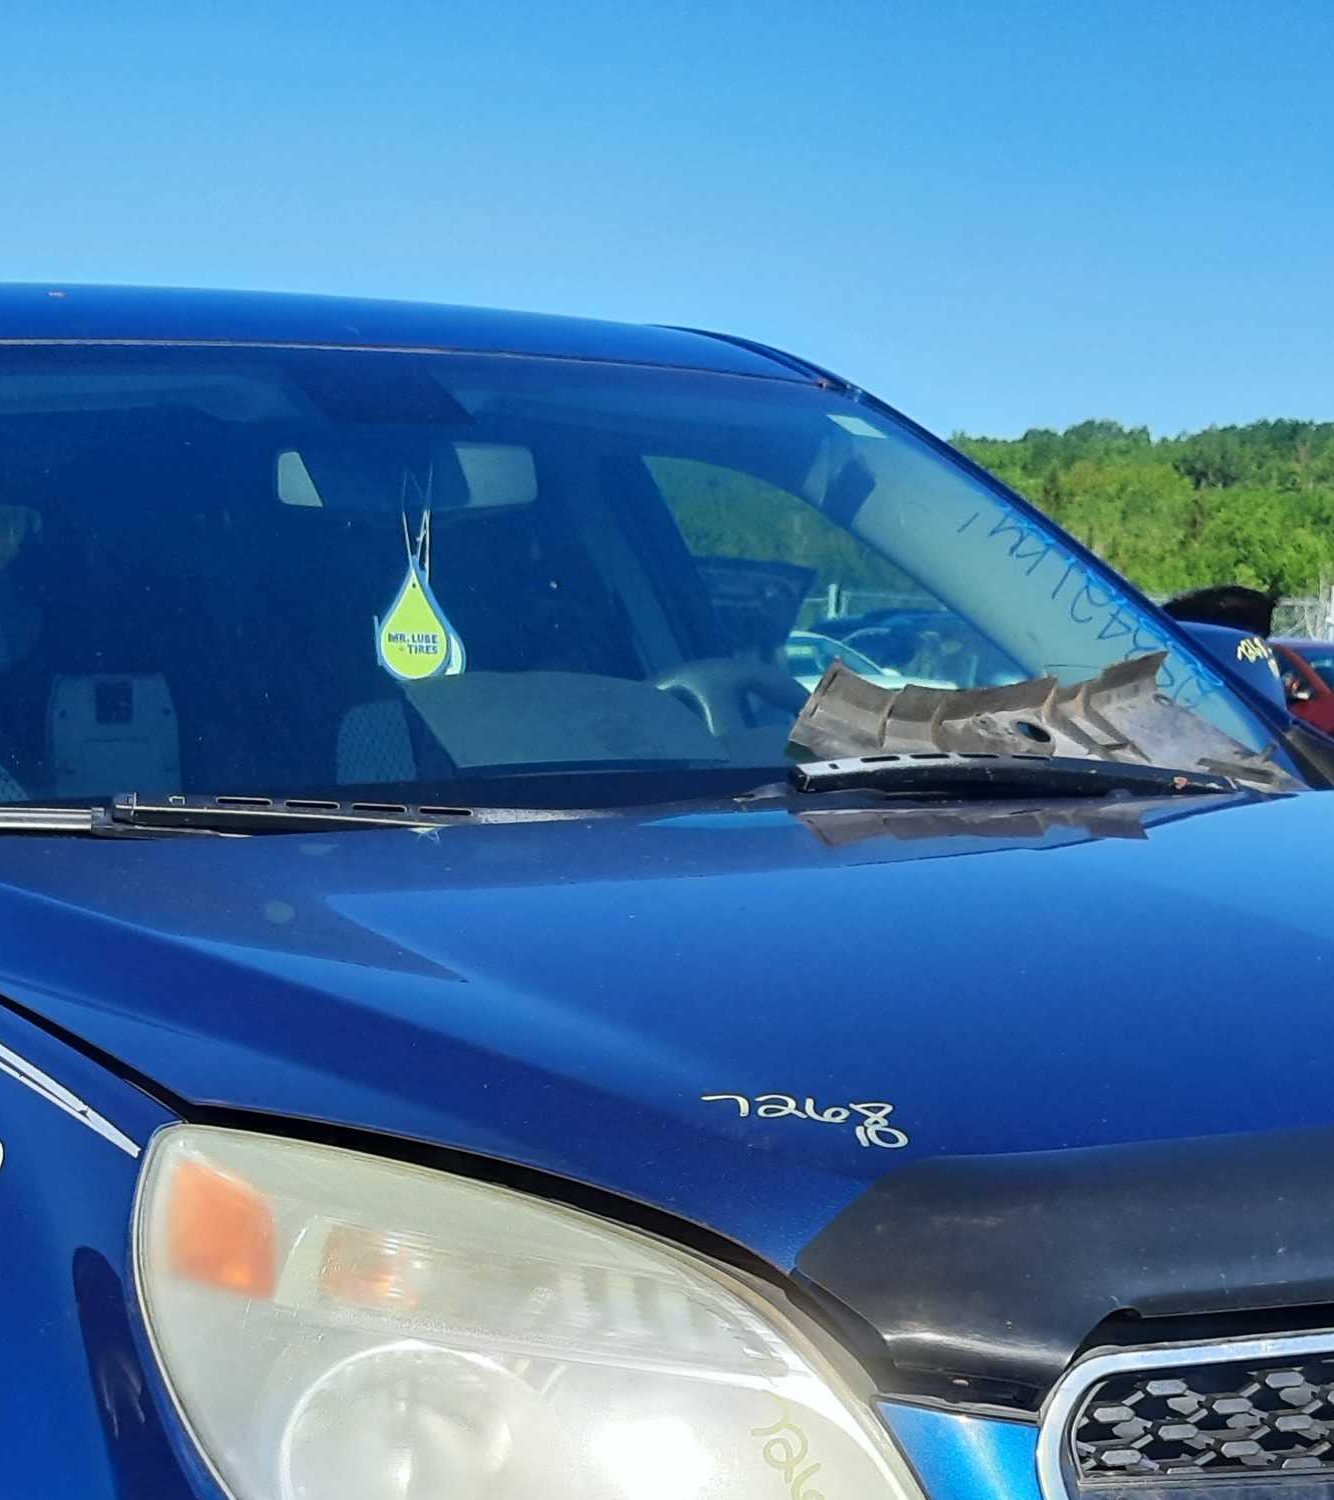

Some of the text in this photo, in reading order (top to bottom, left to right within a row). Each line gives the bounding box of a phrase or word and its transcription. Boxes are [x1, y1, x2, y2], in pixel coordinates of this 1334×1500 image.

[411, 633, 438, 644] LUBE
[407, 644, 438, 655] TIRES
[700, 1094, 894, 1128] 7268
[855, 1125, 909, 1148] 10
